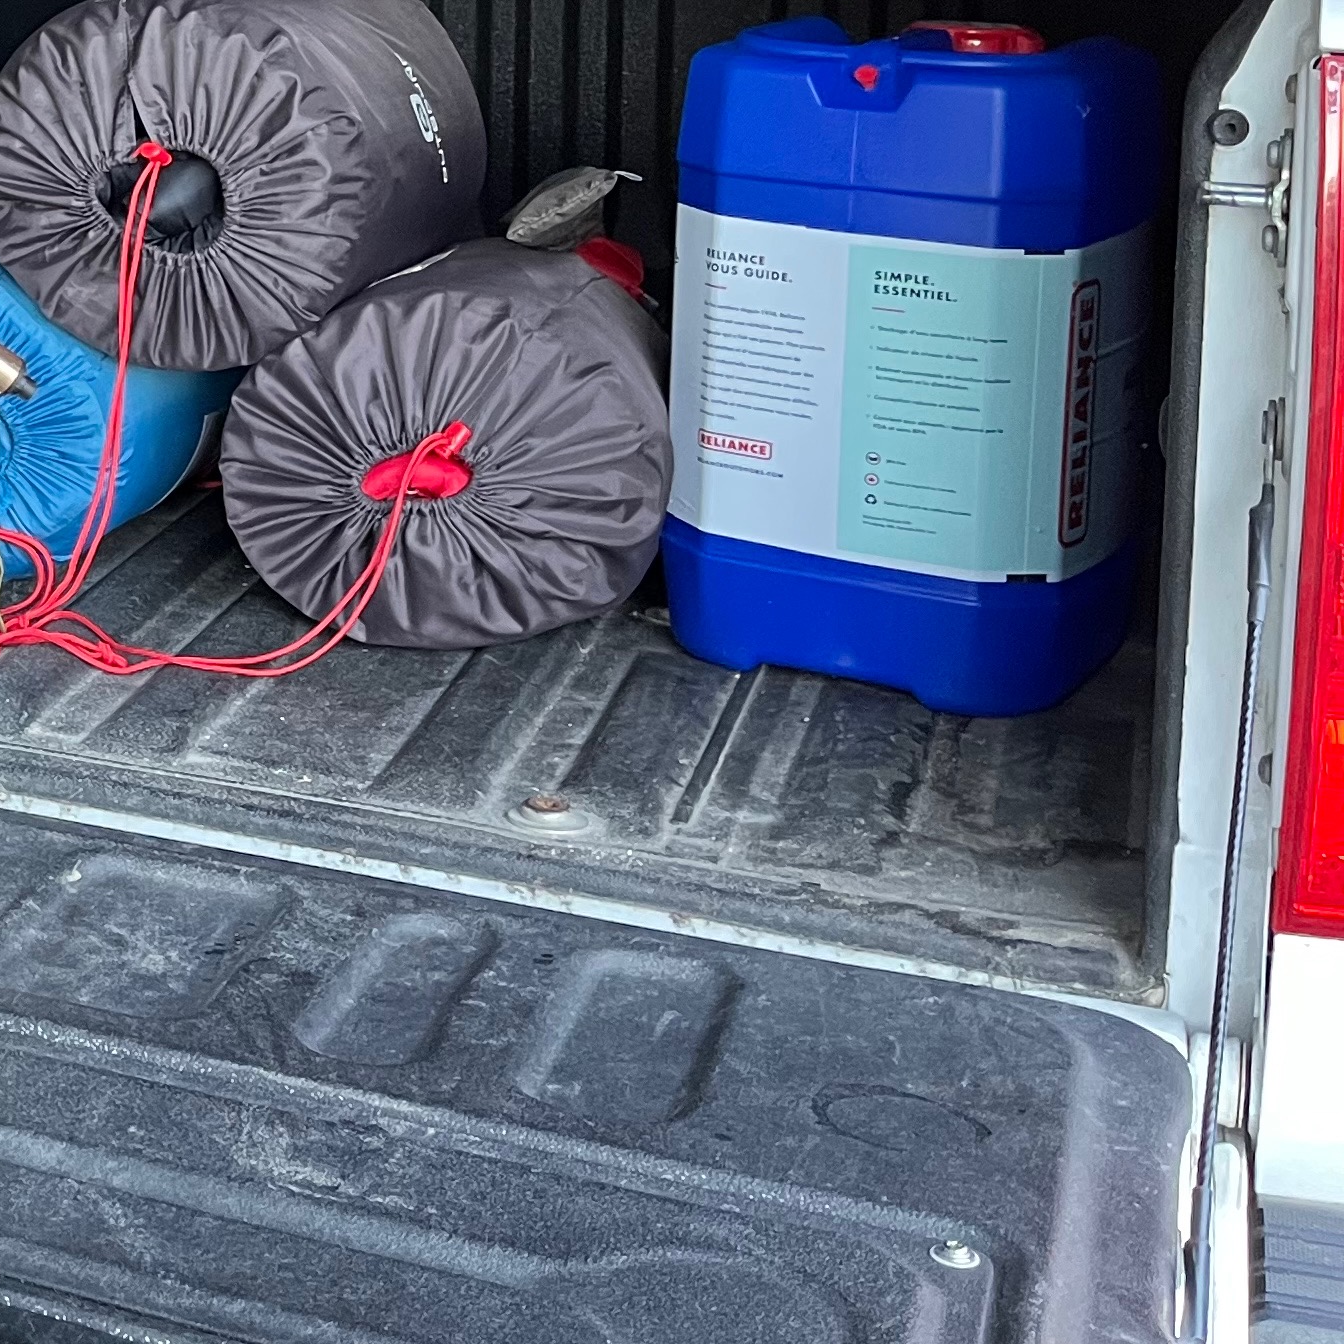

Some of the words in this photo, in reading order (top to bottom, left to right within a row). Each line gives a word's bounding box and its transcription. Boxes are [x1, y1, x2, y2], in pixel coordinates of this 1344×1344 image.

[707, 248, 765, 266] RELIANCE
[706, 261, 738, 276] VOUS
[743, 267, 793, 283] GUIDE.
[874, 270, 935, 287] SIMPLE.
[874, 284, 958, 303] ESSENTIEL.
[1067, 296, 1096, 530] RELIANCE
[700, 433, 767, 456] RELIANCE
